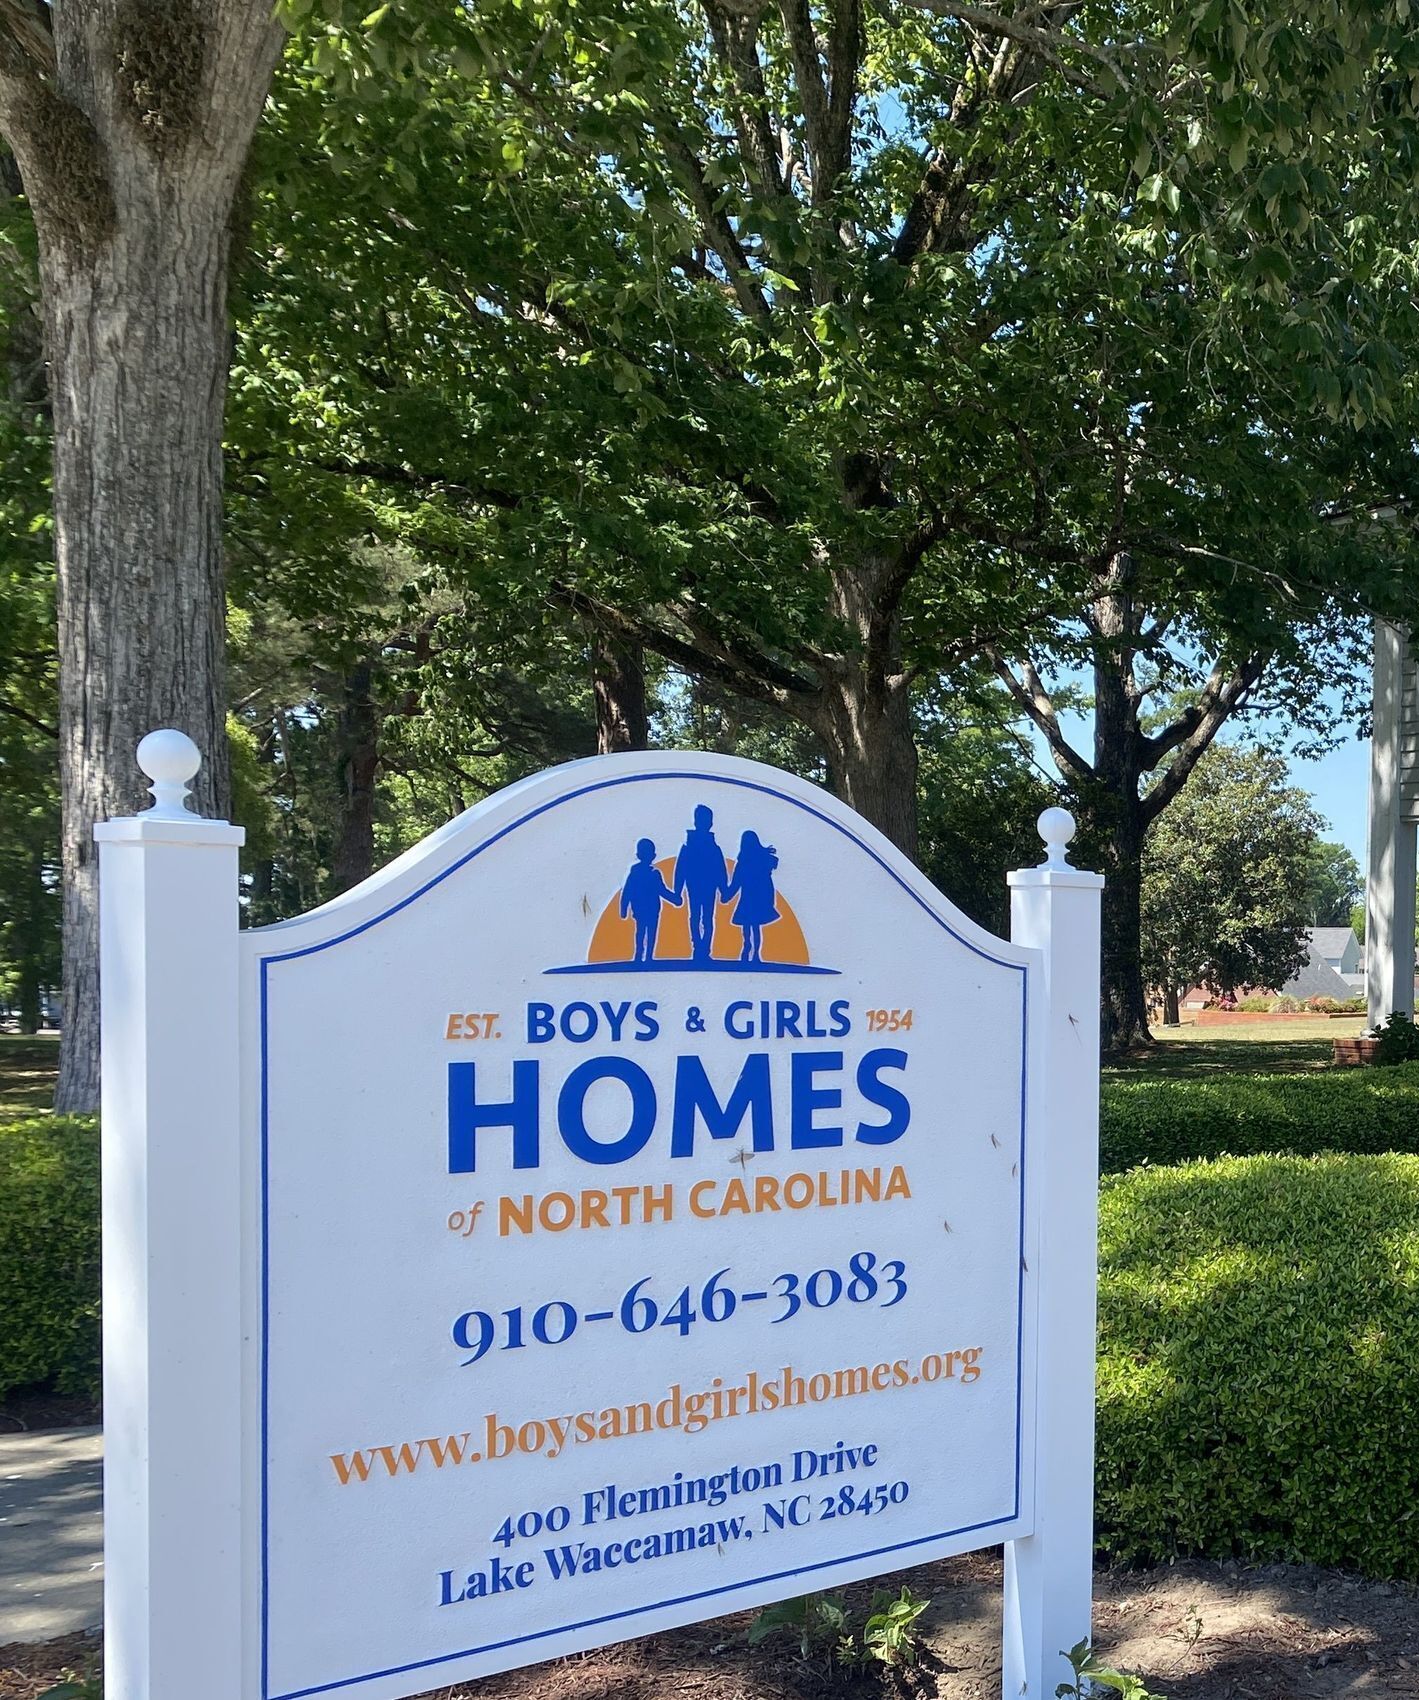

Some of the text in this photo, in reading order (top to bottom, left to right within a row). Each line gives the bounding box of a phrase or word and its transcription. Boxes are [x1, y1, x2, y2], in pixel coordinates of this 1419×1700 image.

[446, 1000, 913, 1044] EST. BOYS & GIRLS 1954
[447, 1047, 911, 1174] HOMES
[447, 1165, 912, 1238] of NORTH CAROLINA
[451, 1251, 909, 1368] 910-646-3083
[329, 1343, 985, 1486] www.boysandgirlshomes.org
[438, 1479, 910, 1607] Lake Waccamaw, NC 28450
[492, 1440, 879, 1548] 400 Flemington Drive
